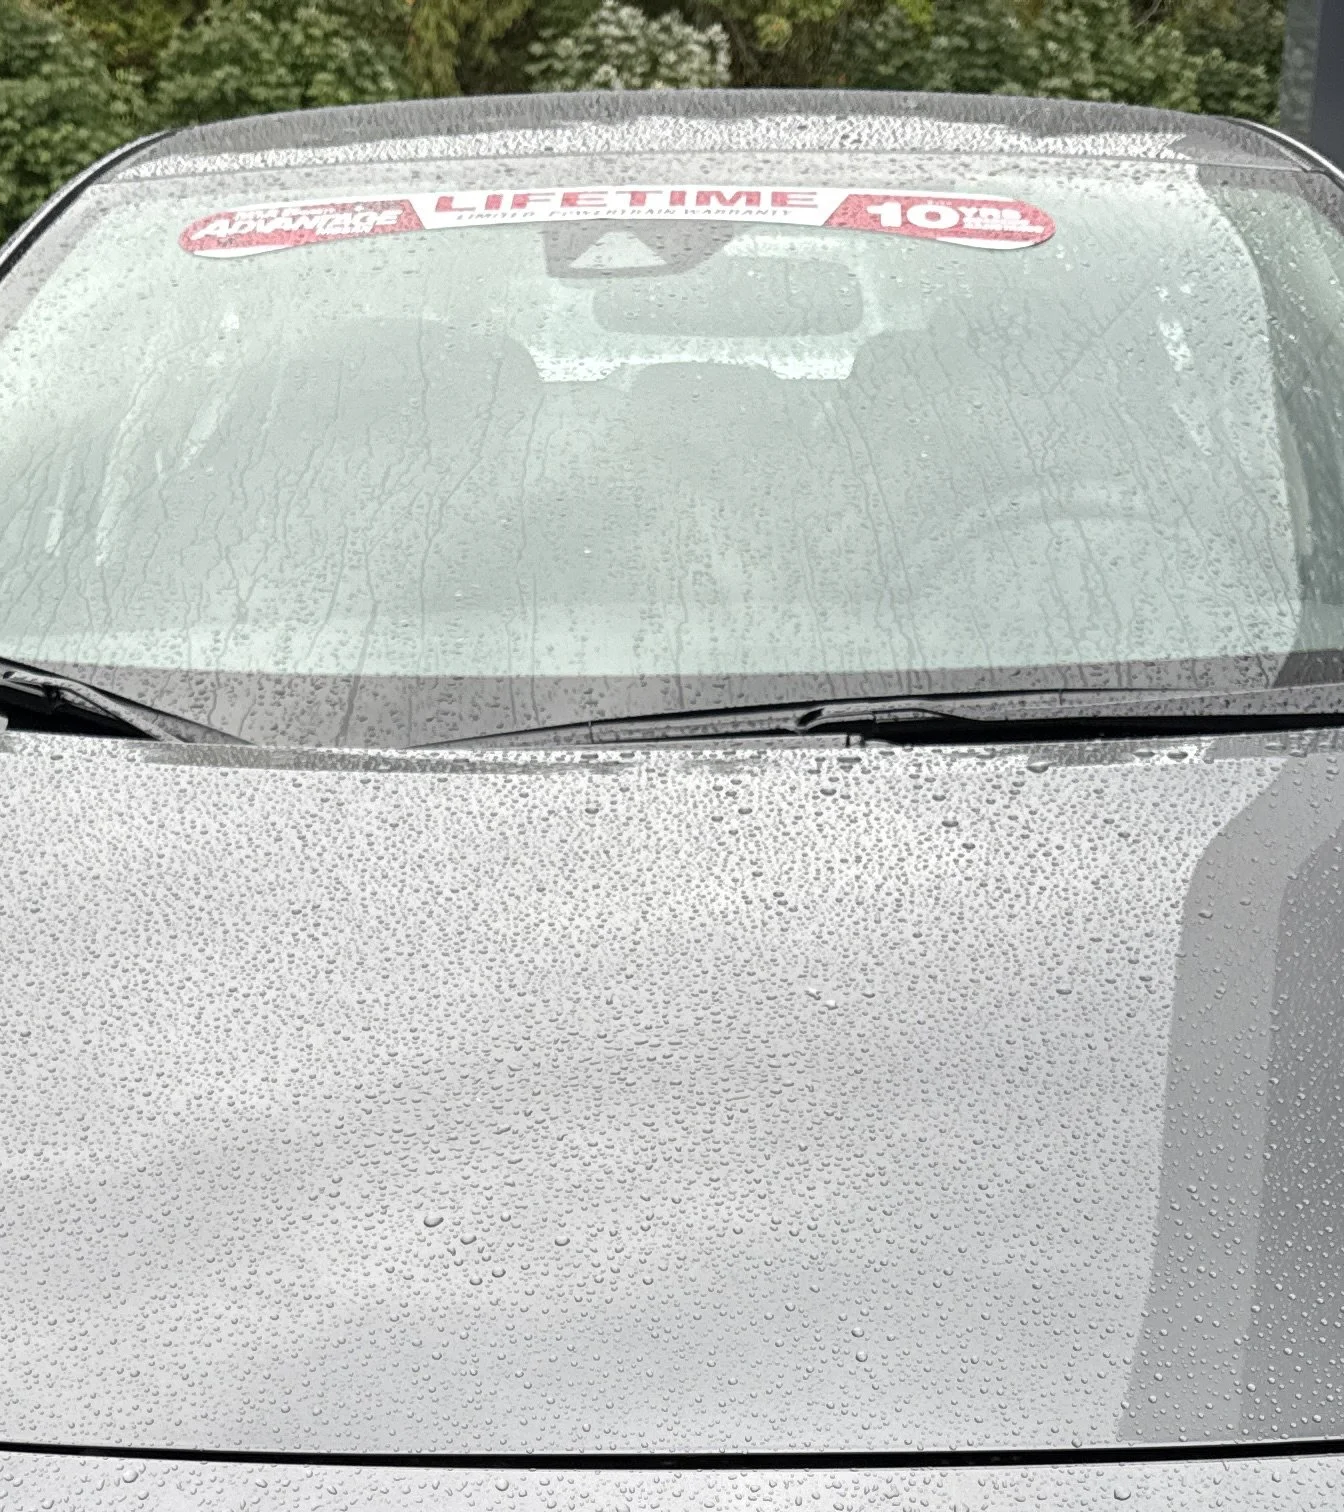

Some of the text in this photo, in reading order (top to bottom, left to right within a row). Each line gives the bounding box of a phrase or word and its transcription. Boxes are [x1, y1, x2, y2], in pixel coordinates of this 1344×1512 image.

[435, 190, 819, 213] LIFETIME
[866, 200, 960, 230] 10
[189, 208, 403, 241] ADVANTAGE
